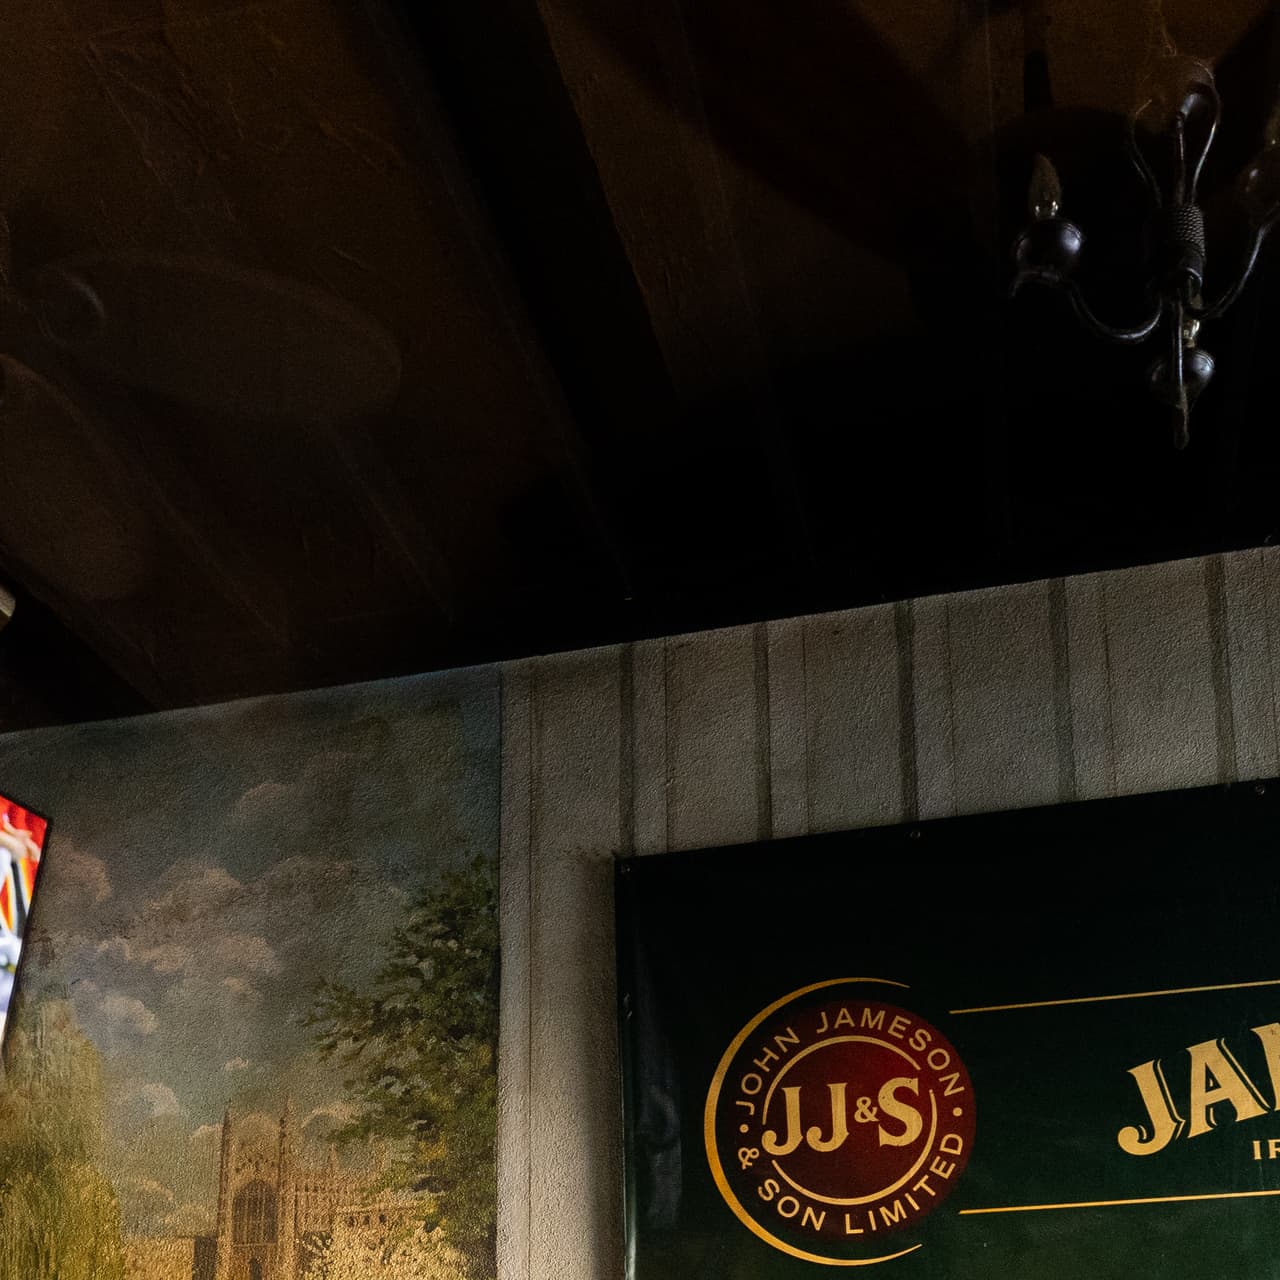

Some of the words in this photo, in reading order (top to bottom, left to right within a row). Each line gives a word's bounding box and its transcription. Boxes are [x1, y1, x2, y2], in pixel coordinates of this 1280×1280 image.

[736, 1027, 800, 1116] JOHN
[816, 1007, 964, 1096] JAMESON
[761, 1077, 923, 1157] JJ&S
[739, 1146, 760, 1170] &
[758, 1178, 826, 1232] SON
[845, 1133, 964, 1235] LIMITED
